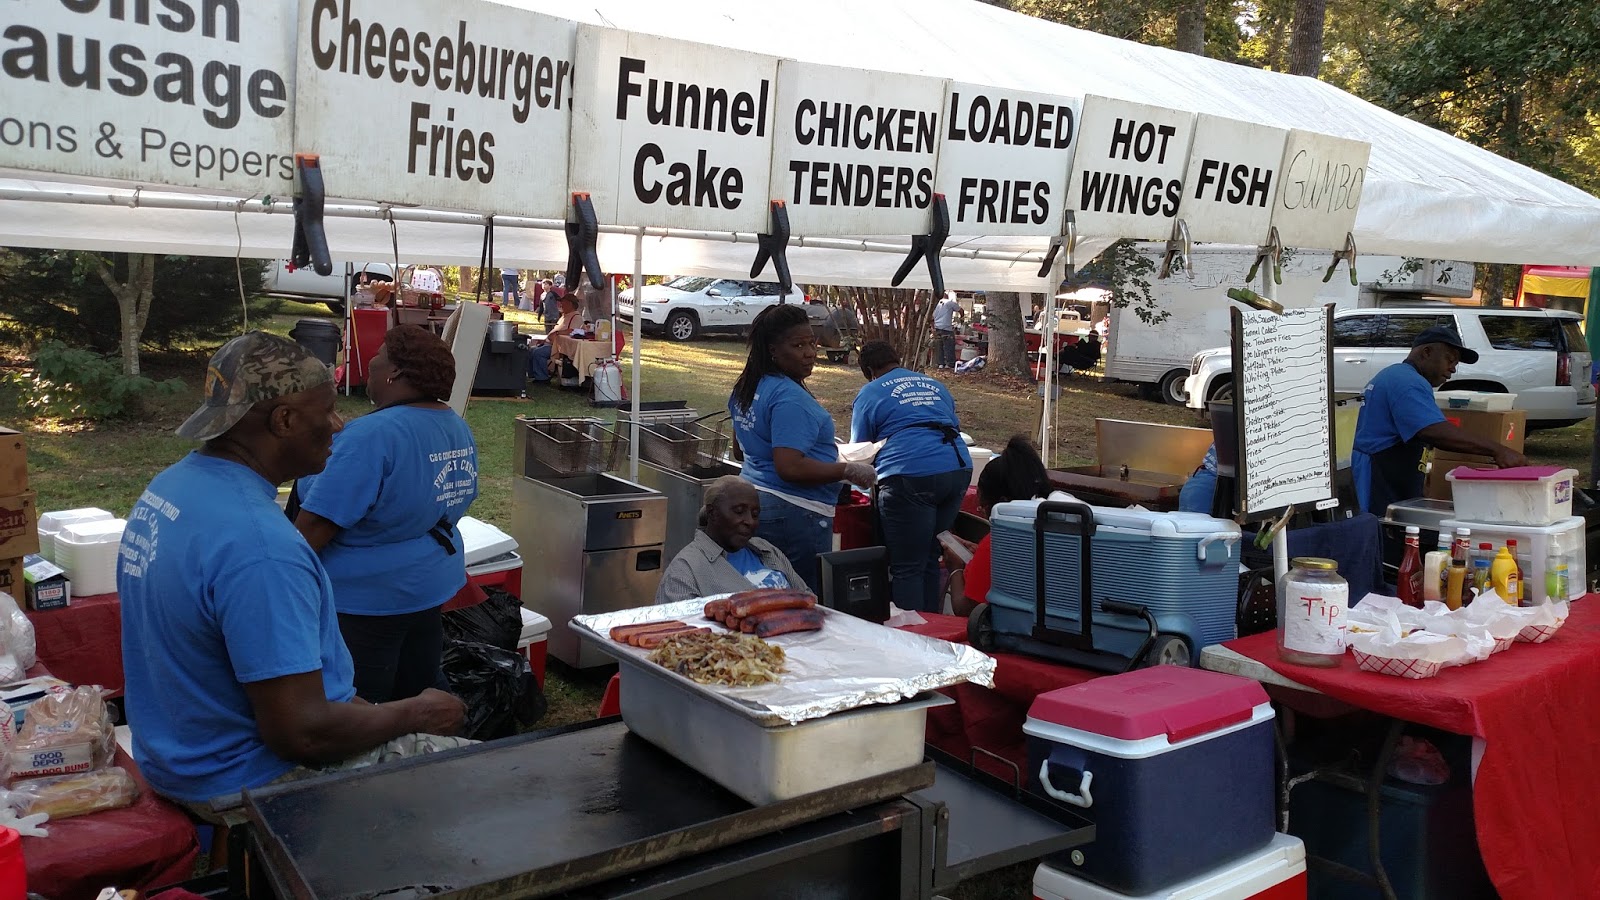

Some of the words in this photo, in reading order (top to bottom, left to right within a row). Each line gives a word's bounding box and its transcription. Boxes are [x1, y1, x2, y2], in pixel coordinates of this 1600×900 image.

[616, 56, 771, 138] Funnel
[794, 98, 937, 154] CHICKEN
[947, 92, 1074, 150] LOADED
[95, 121, 124, 159] &
[141, 127, 295, 181] Peppers
[407, 102, 495, 184] Fries
[1108, 117, 1177, 165] HOT
[633, 142, 744, 210] Cake
[788, 159, 933, 210] TENDERS
[1194, 158, 1273, 208] FISH
[1283, 149, 1363, 214] GUMBO
[956, 177, 1051, 225] FRIES
[1080, 170, 1186, 219] WINGS
[1278, 334, 1292, 342] Fries
[1274, 345, 1289, 355] Fries
[1244, 371, 1270, 384] Whiting
[1270, 367, 1287, 376] Plate
[890, 381, 915, 398] FUNNEL
[916, 381, 940, 393] CAKES
[1245, 385, 1257, 394] Hot
[1258, 382, 1273, 392] Dog
[1245, 424, 1262, 436] Fried
[1246, 433, 1266, 448] Loaded
[1267, 430, 1282, 441] Fries
[1246, 448, 1262, 459] Fries
[1247, 475, 1272, 490] Lemonade
[1247, 488, 1263, 502] Soda
[1300, 597, 1340, 626] Tip
[32, 758, 66, 768] DEPOT
[34, 751, 63, 761] FOOD
[42, 767, 62, 775] DOG
[64, 762, 90, 772] BUNS
